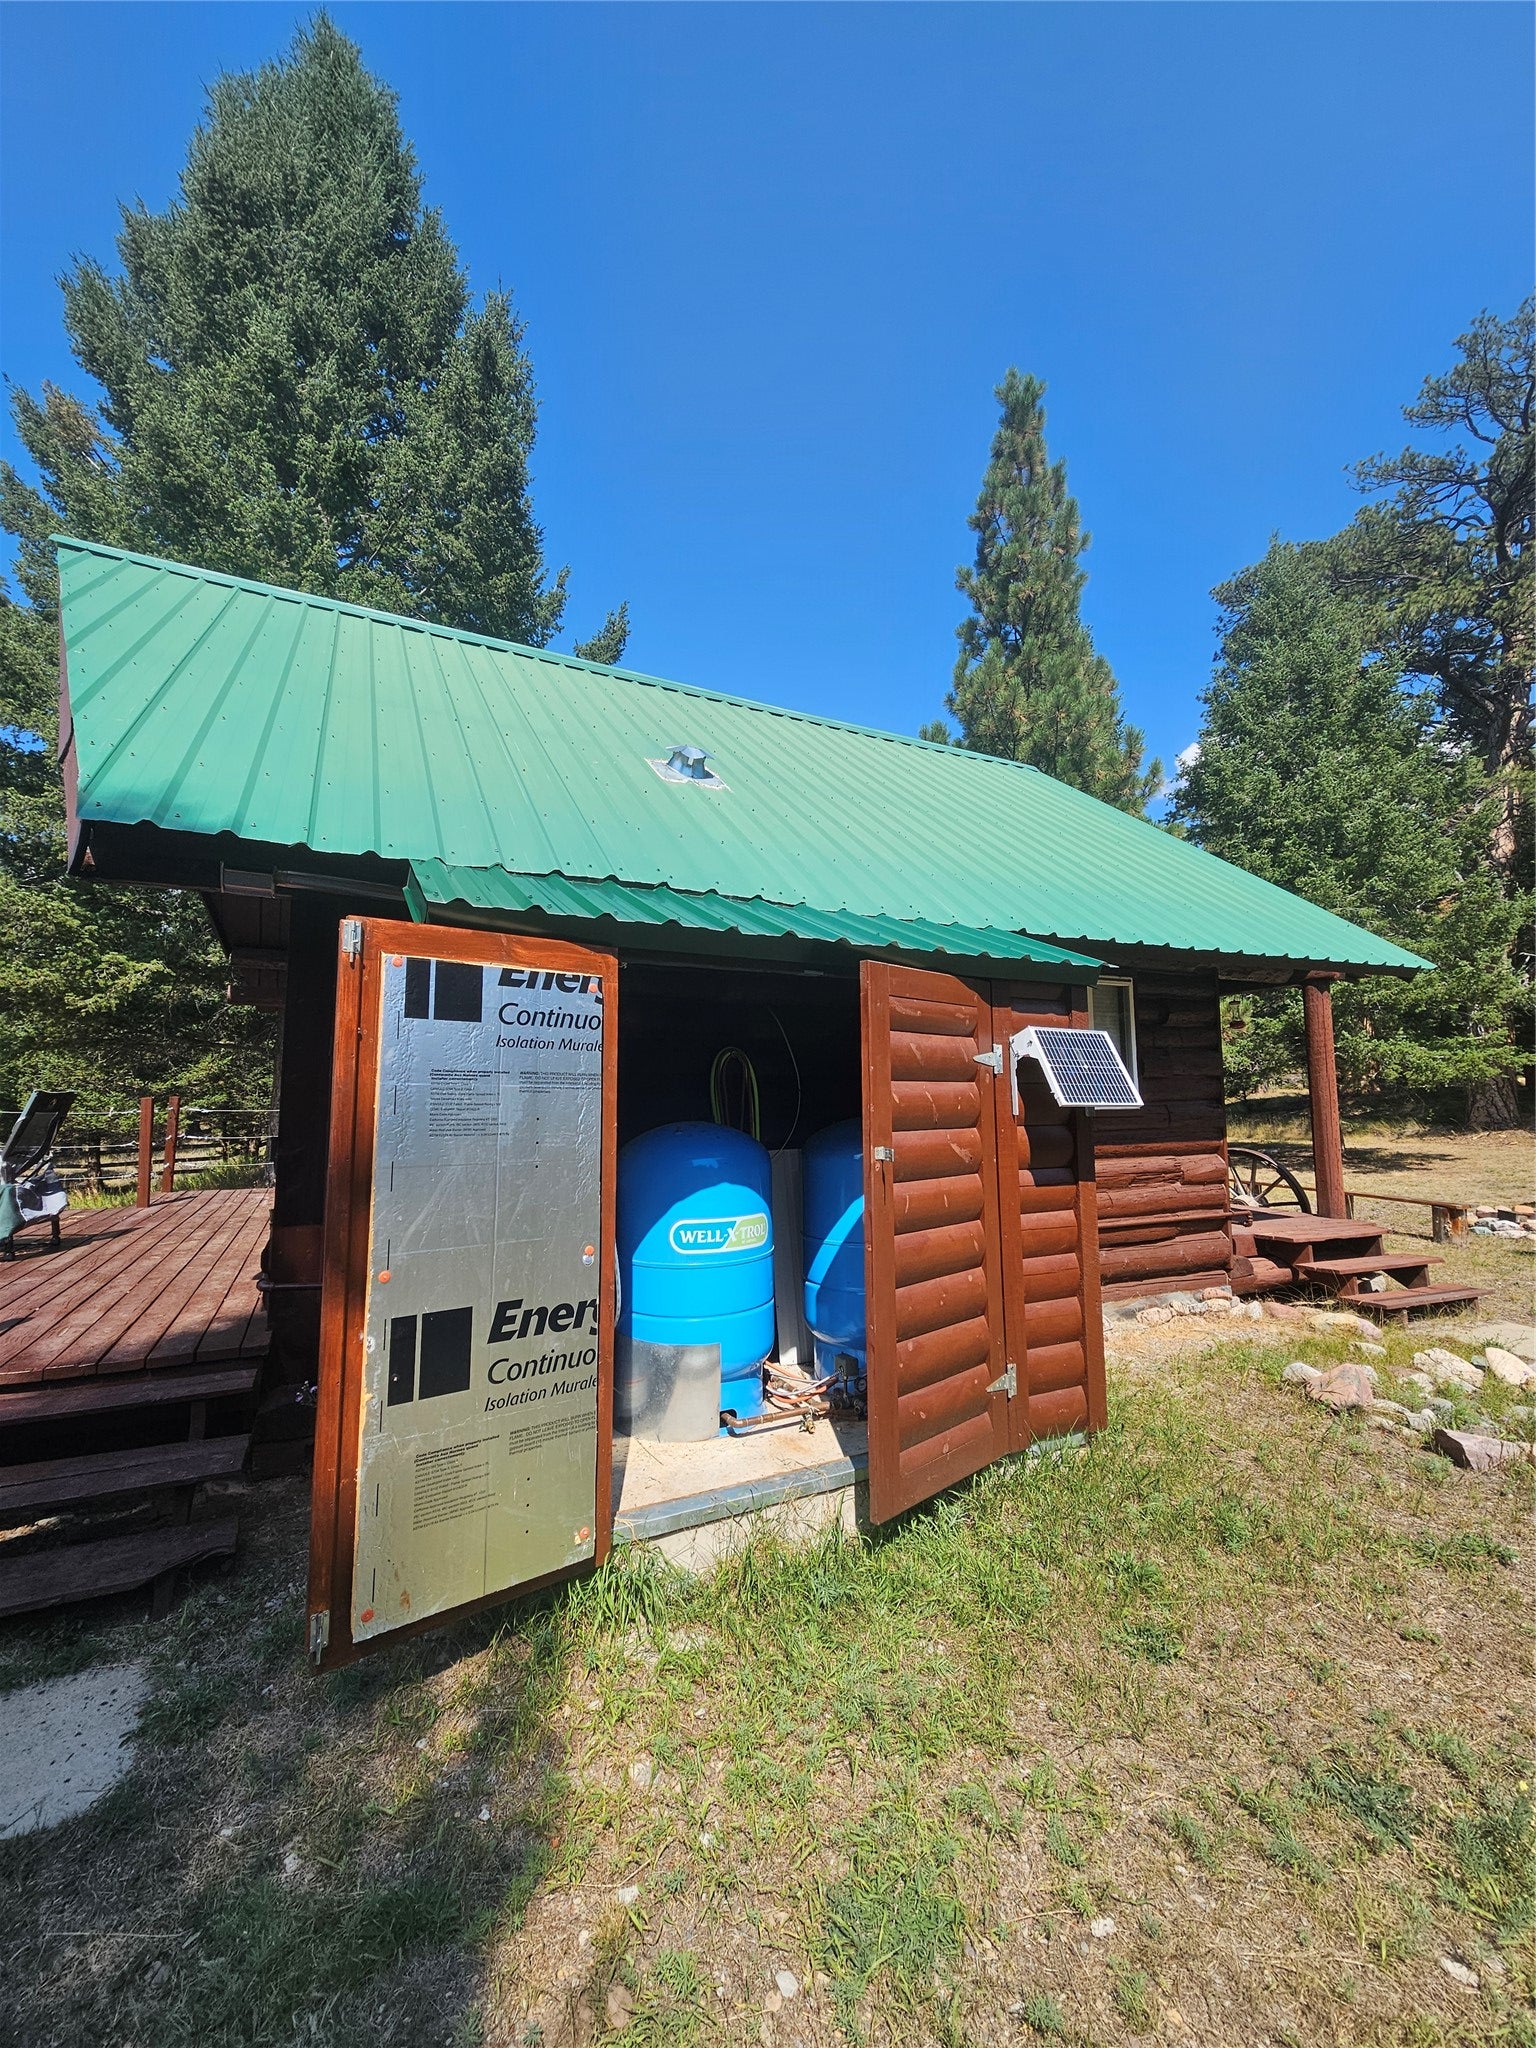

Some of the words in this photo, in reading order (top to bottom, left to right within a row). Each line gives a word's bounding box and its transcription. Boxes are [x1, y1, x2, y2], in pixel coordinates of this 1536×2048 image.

[498, 968, 602, 1005] Ener
[498, 1002, 601, 1030] Continuo
[496, 1035, 554, 1050] Isolation
[558, 1038, 602, 1052] Murale
[679, 1223, 766, 1244] WELL-X-TROL
[487, 1299, 598, 1345] Ener
[488, 1348, 597, 1385] Continuo
[484, 1388, 547, 1412] Isolation
[551, 1375, 597, 1397] Murale
